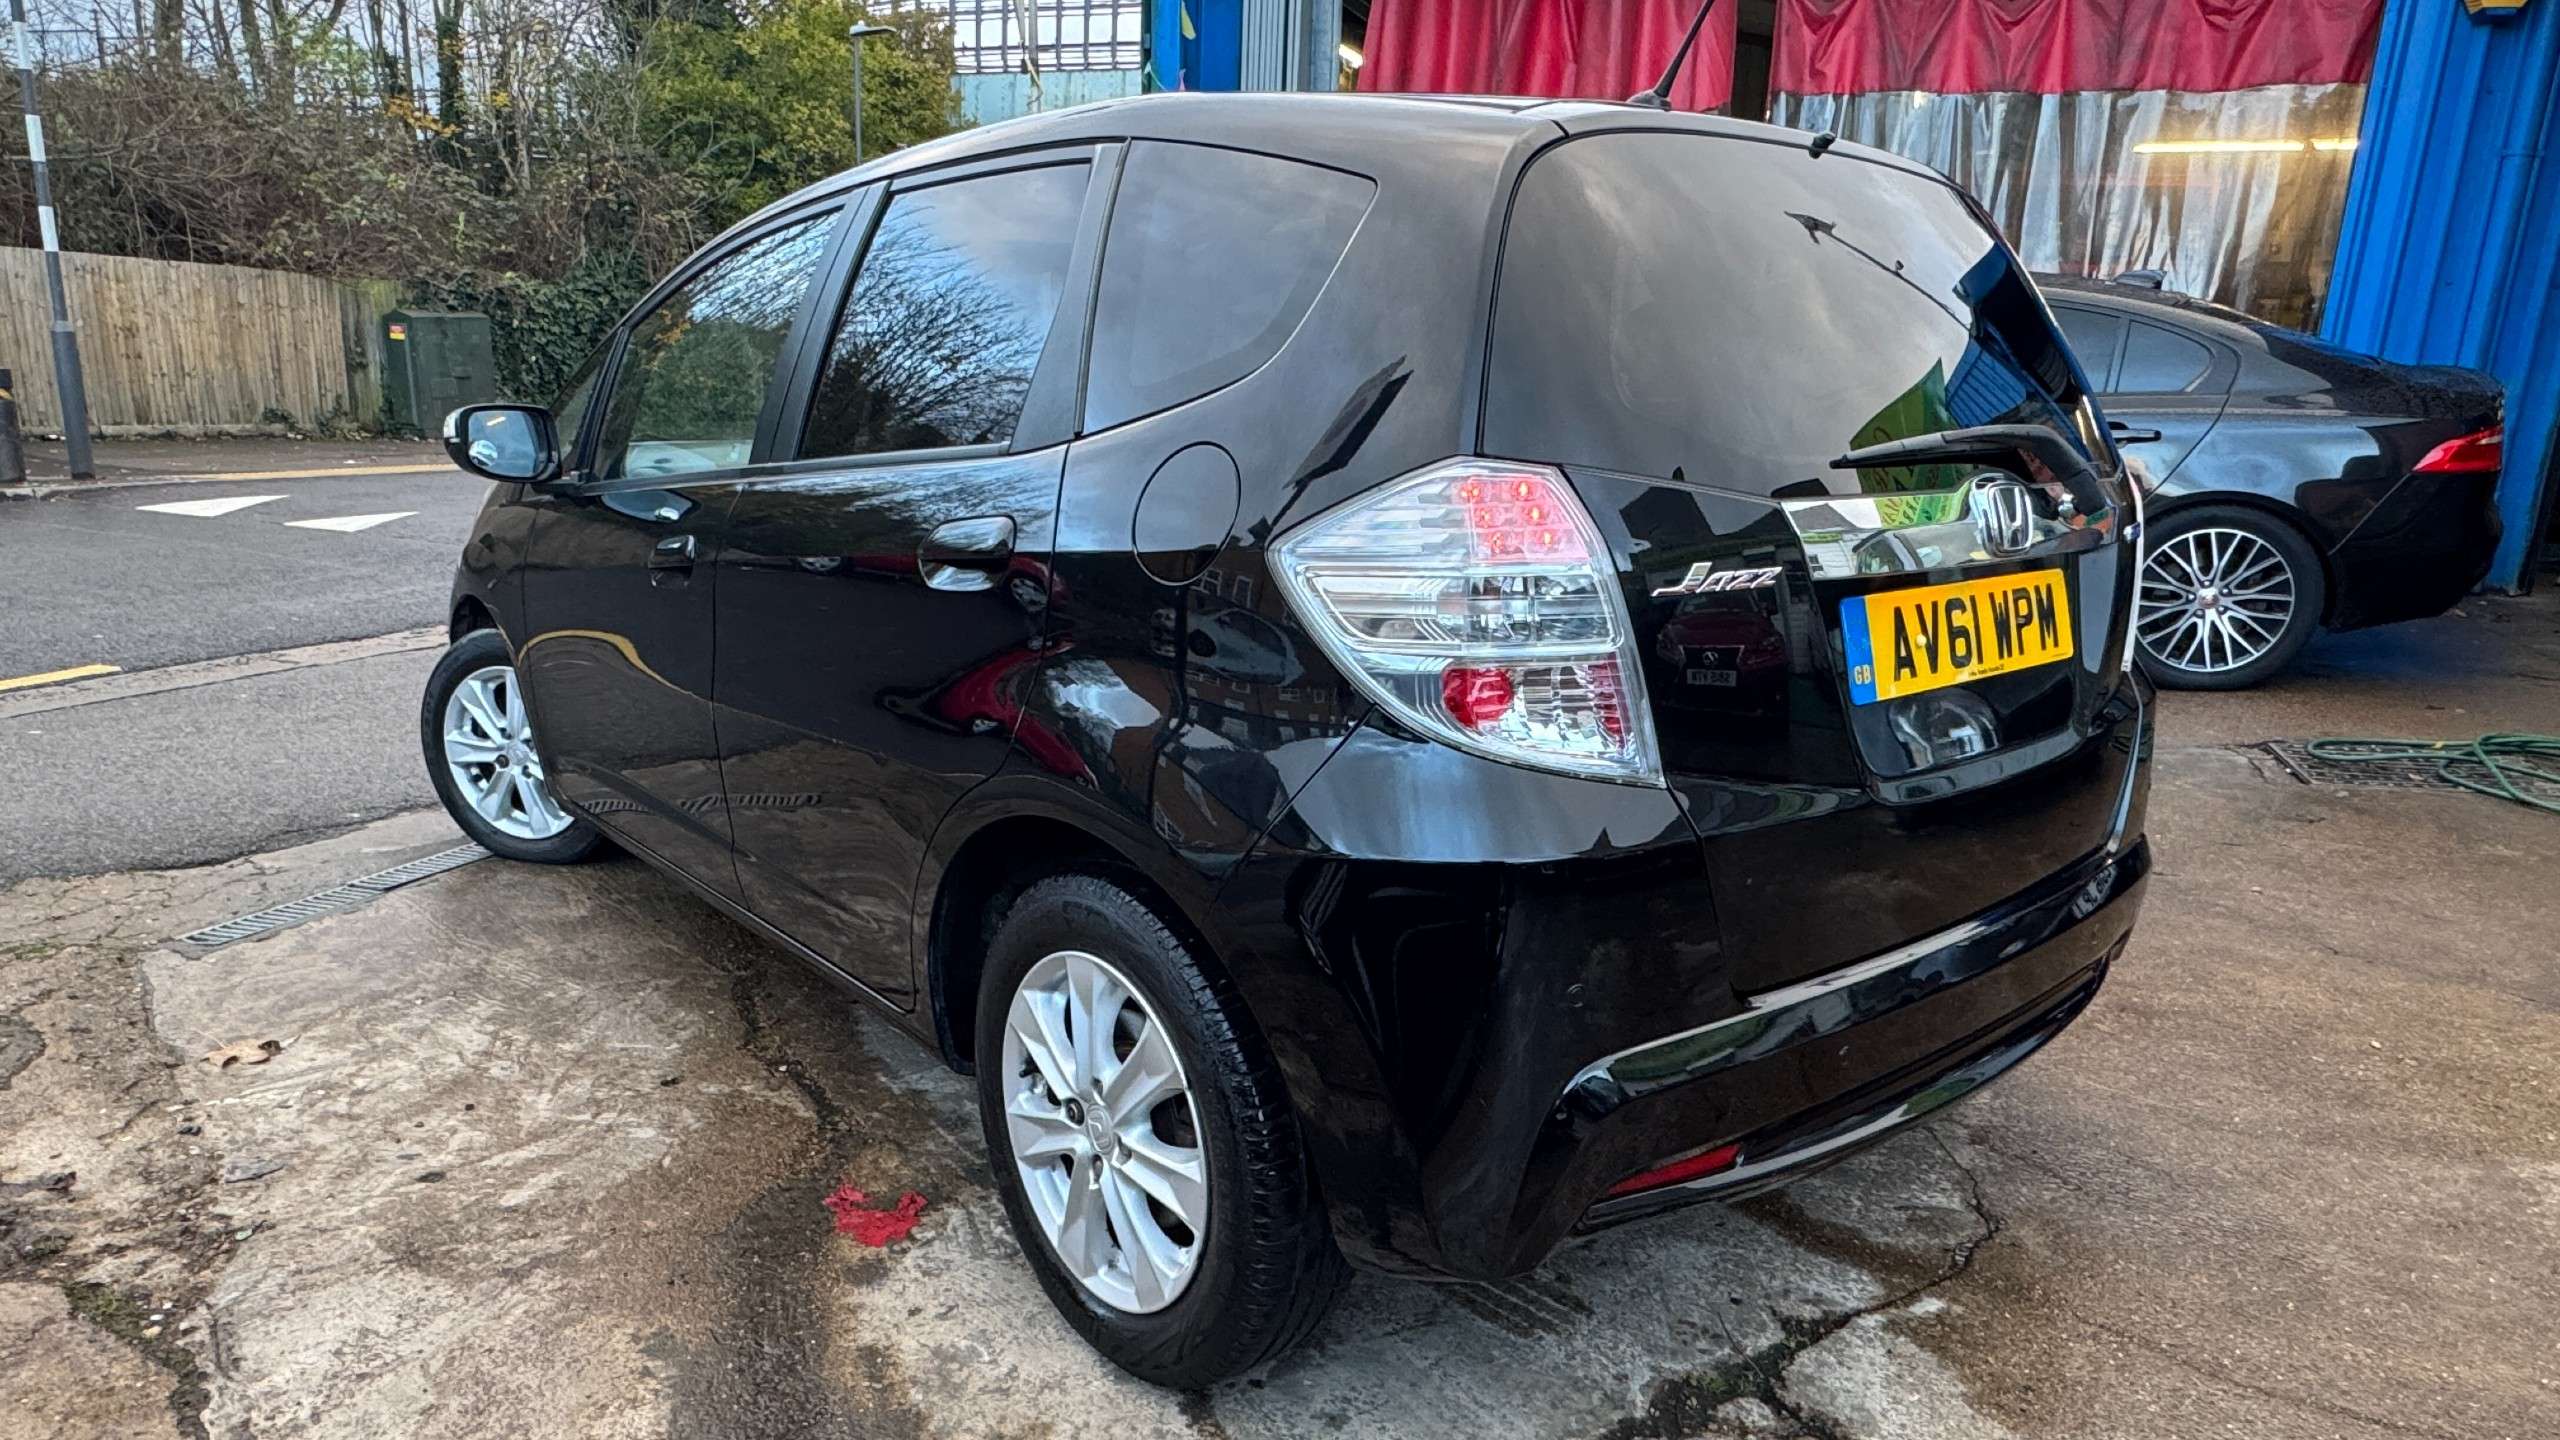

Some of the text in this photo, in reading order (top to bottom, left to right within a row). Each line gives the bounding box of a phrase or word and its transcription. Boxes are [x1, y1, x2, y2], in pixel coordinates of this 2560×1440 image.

[1893, 583, 2059, 683] AV61 WPM
[1854, 664, 1872, 686] GB
